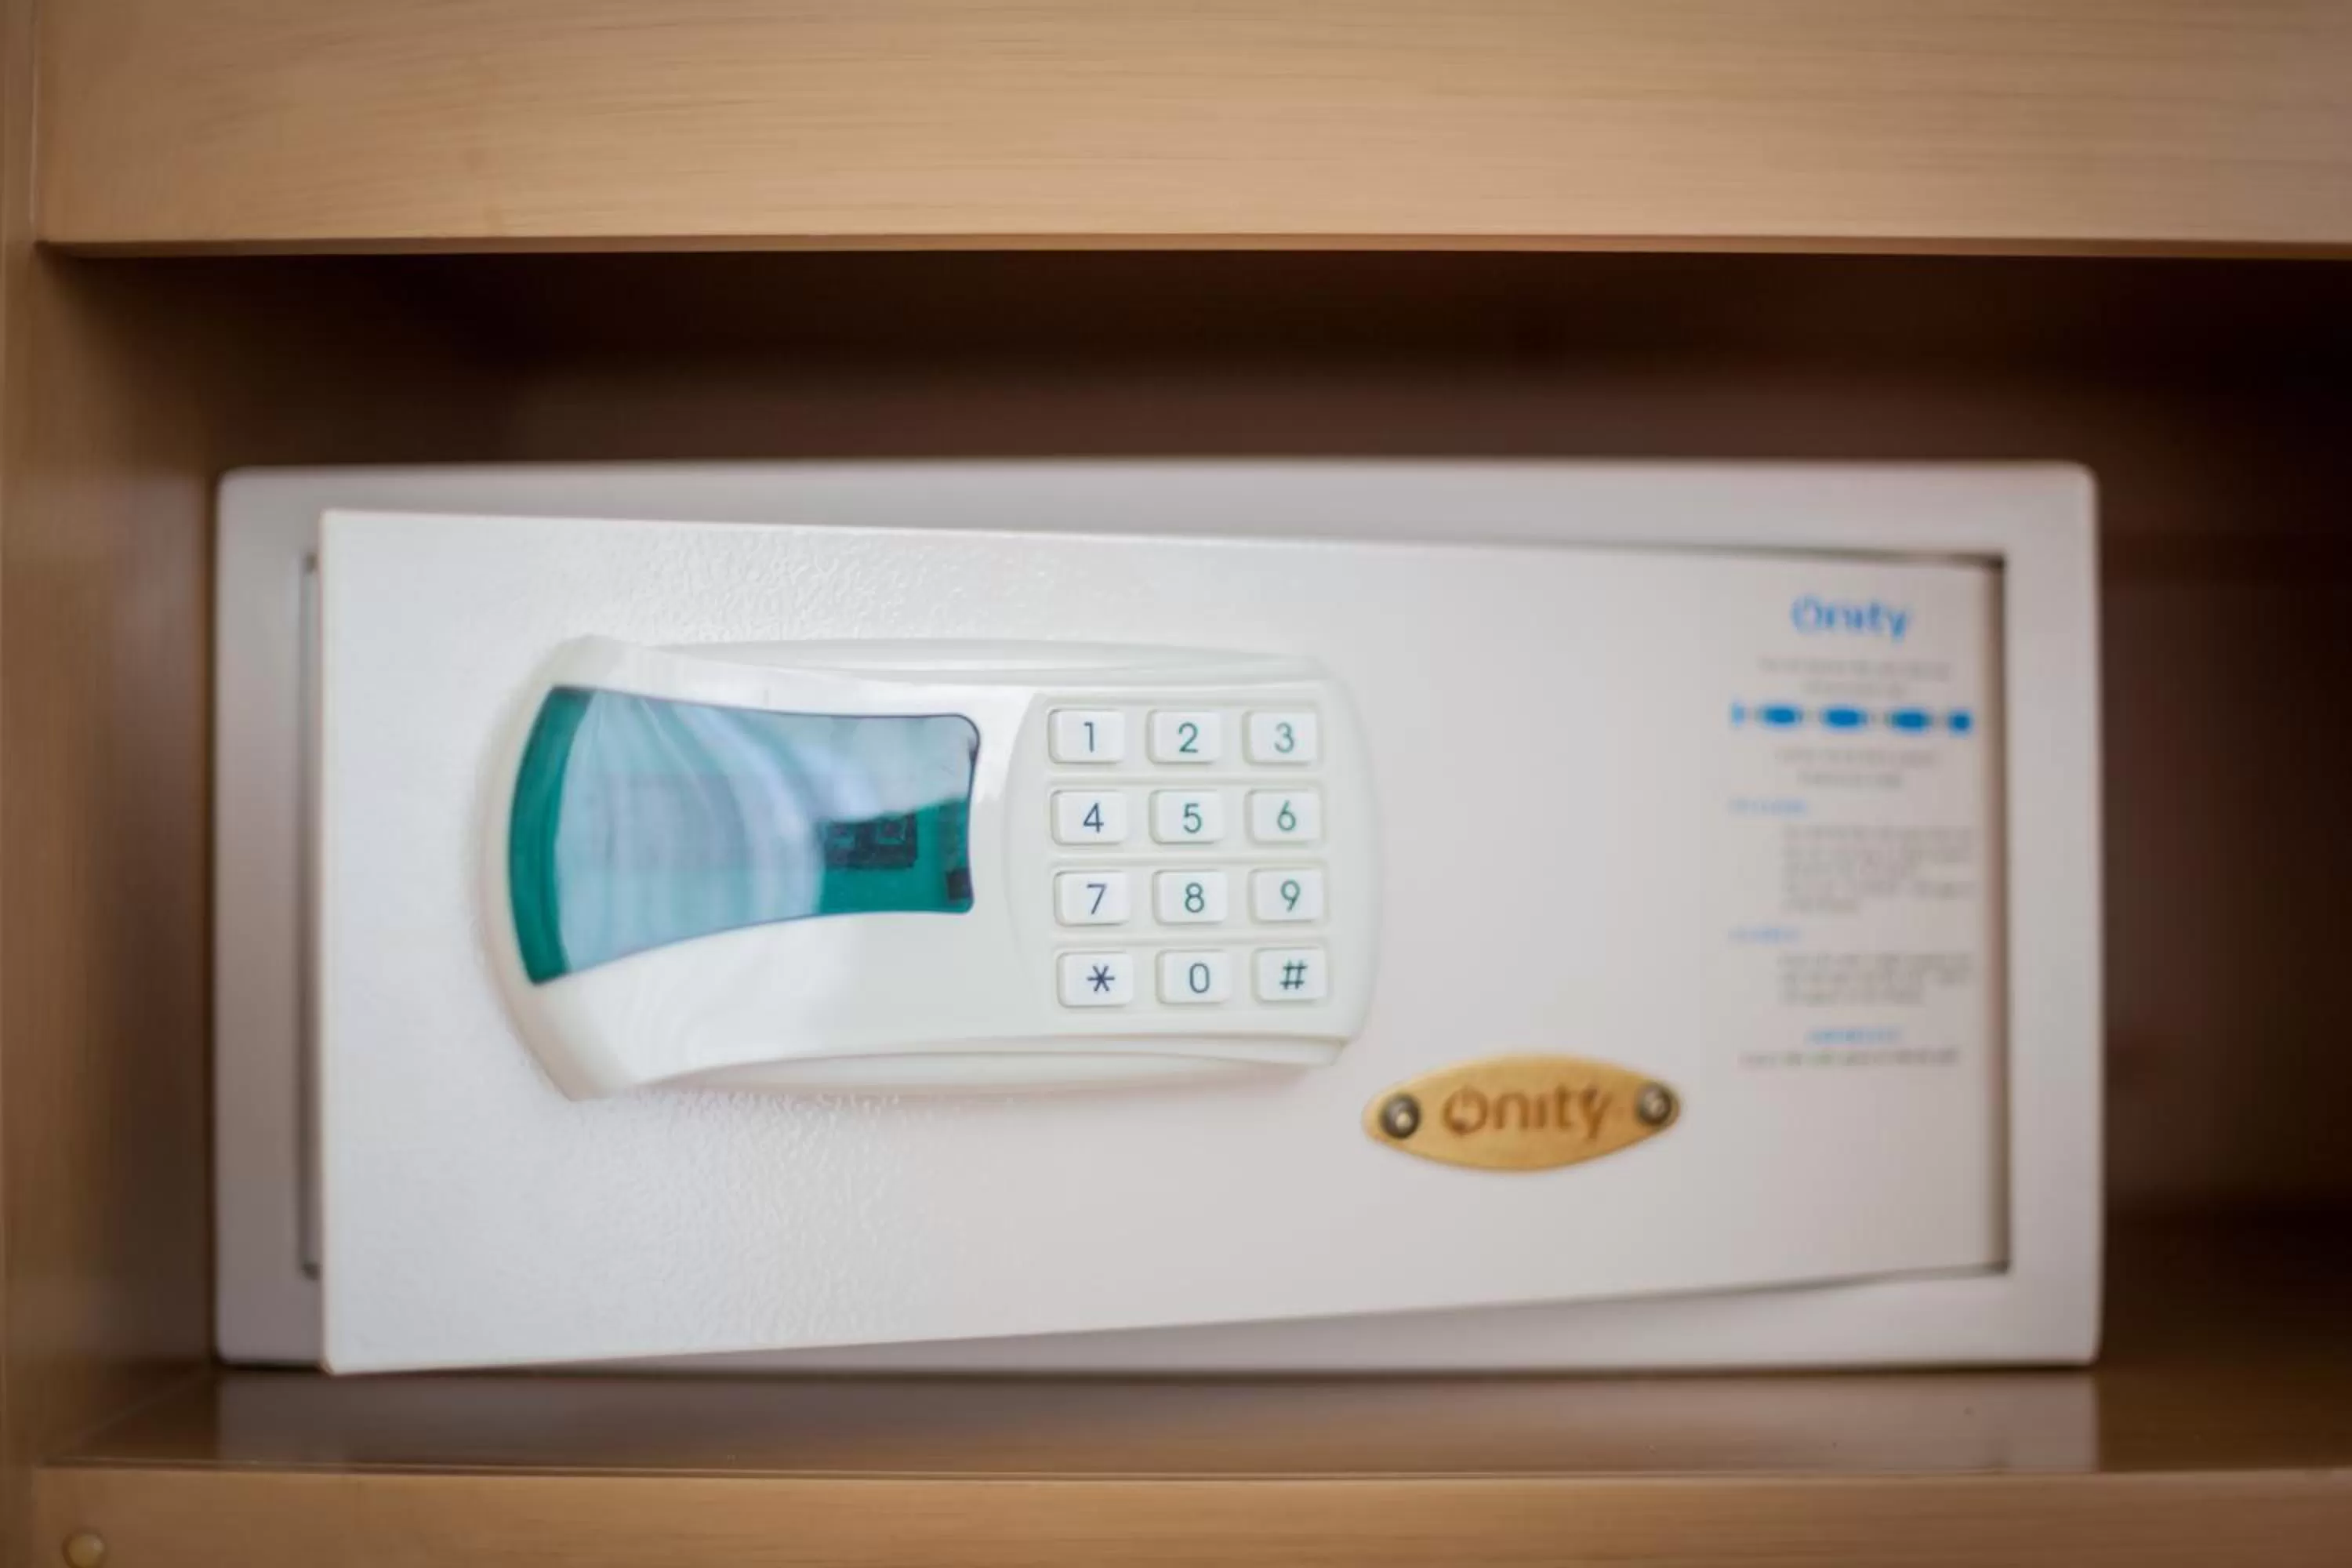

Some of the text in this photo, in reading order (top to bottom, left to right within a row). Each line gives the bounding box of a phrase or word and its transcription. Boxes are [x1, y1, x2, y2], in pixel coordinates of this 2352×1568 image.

[1083, 721, 1295, 753] 1 2 3
[1083, 800, 1297, 833] 4 5 6
[1087, 880, 1301, 915] 7 8 9
[1189, 962, 1210, 993] 0
[1280, 960, 1308, 989] #
[1440, 1083, 1613, 1139] Onity
